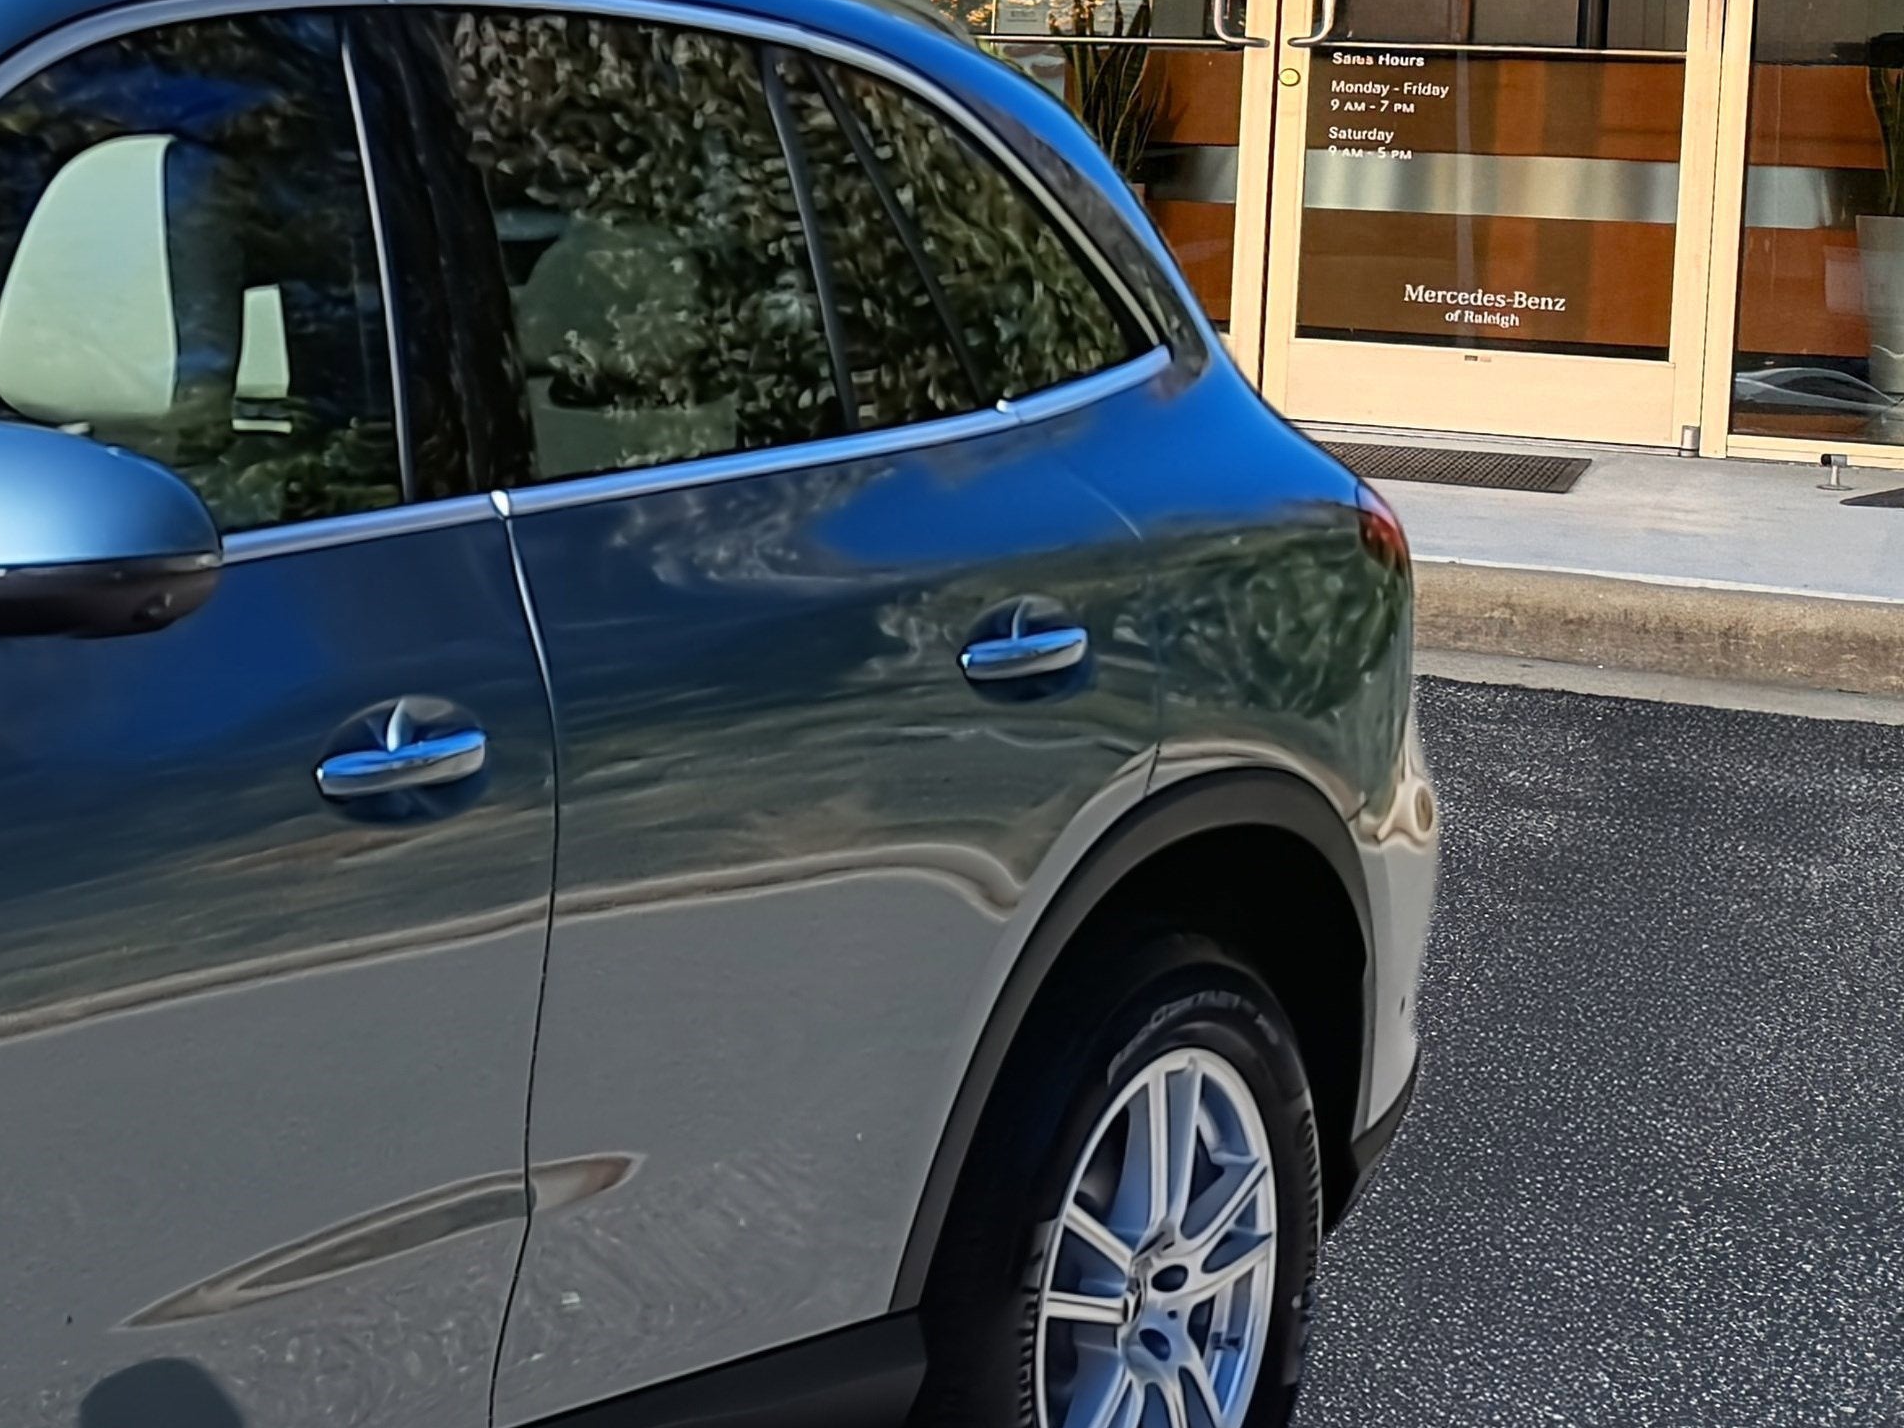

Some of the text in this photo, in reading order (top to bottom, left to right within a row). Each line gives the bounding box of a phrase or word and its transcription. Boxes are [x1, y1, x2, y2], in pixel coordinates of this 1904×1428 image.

[1378, 53, 1425, 67] Hours
[1331, 80, 1390, 97] Monday
[1403, 82, 1449, 98] Friday
[1330, 99, 1340, 111] 9
[1344, 101, 1366, 112] AM
[1380, 100, 1389, 112] 7
[1393, 103, 1415, 113] PM
[1328, 126, 1394, 143] Saturday
[1328, 145, 1338, 157] 9
[1342, 148, 1364, 158] AM
[1377, 147, 1387, 159] 5
[1391, 149, 1412, 160] PM
[1403, 284, 1566, 312] Mercedes-Benz
[1445, 310, 1520, 328] of Raleigh
